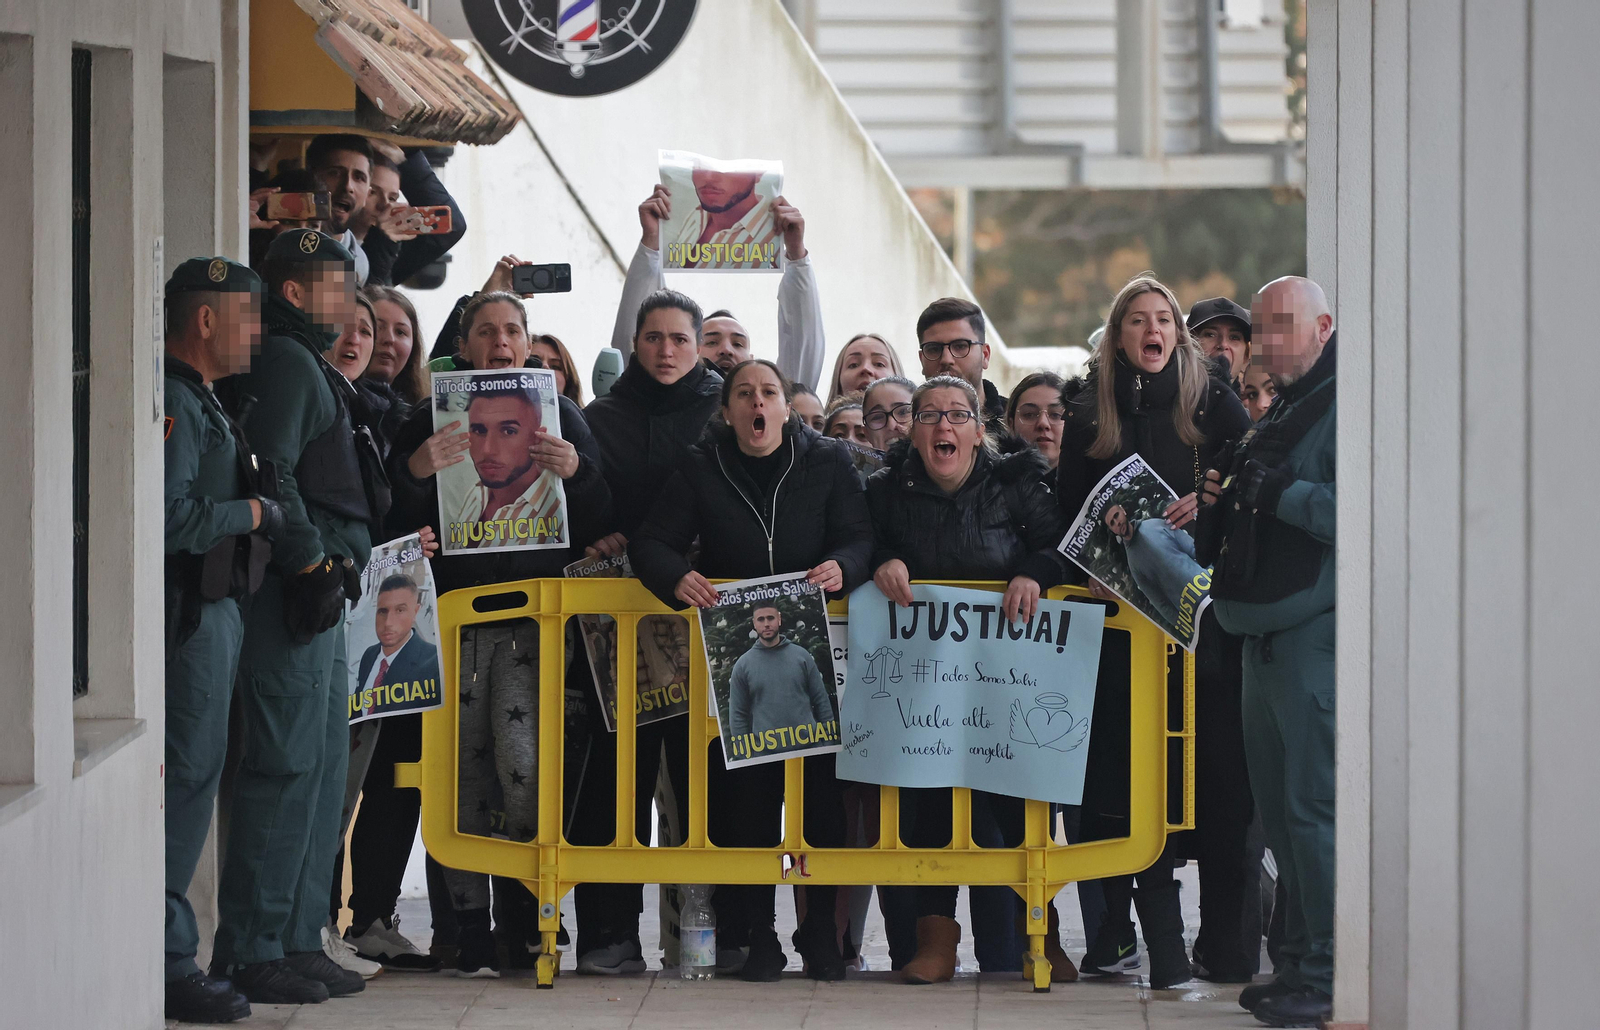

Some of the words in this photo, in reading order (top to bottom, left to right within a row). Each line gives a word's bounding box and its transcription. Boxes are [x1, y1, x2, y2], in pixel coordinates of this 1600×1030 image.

[669, 243, 774, 267] ¡¡JUSTICIA!!
[436, 379, 477, 394] ¡¡Todos
[480, 379, 517, 391] somos
[520, 375, 553, 389] Salvi!!
[1066, 519, 1096, 558] ¡¡Todos
[1090, 486, 1114, 520] somos
[1110, 459, 1146, 489] Salvi!!
[449, 516, 559, 547] ¡¡JUSTICIA!!
[370, 554, 398, 573] somos
[744, 587, 780, 602] somos
[911, 659, 969, 683] #Todos
[974, 661, 1006, 684] Somos
[1008, 667, 1037, 687] Salvi
[348, 678, 436, 719] JUSTICIA!!
[897, 698, 954, 728] Vuela
[961, 706, 995, 728] alto
[731, 720, 838, 758] ¡¡JUSTICIA!!
[901, 738, 954, 756] nuestro
[968, 742, 1016, 764] angelito
